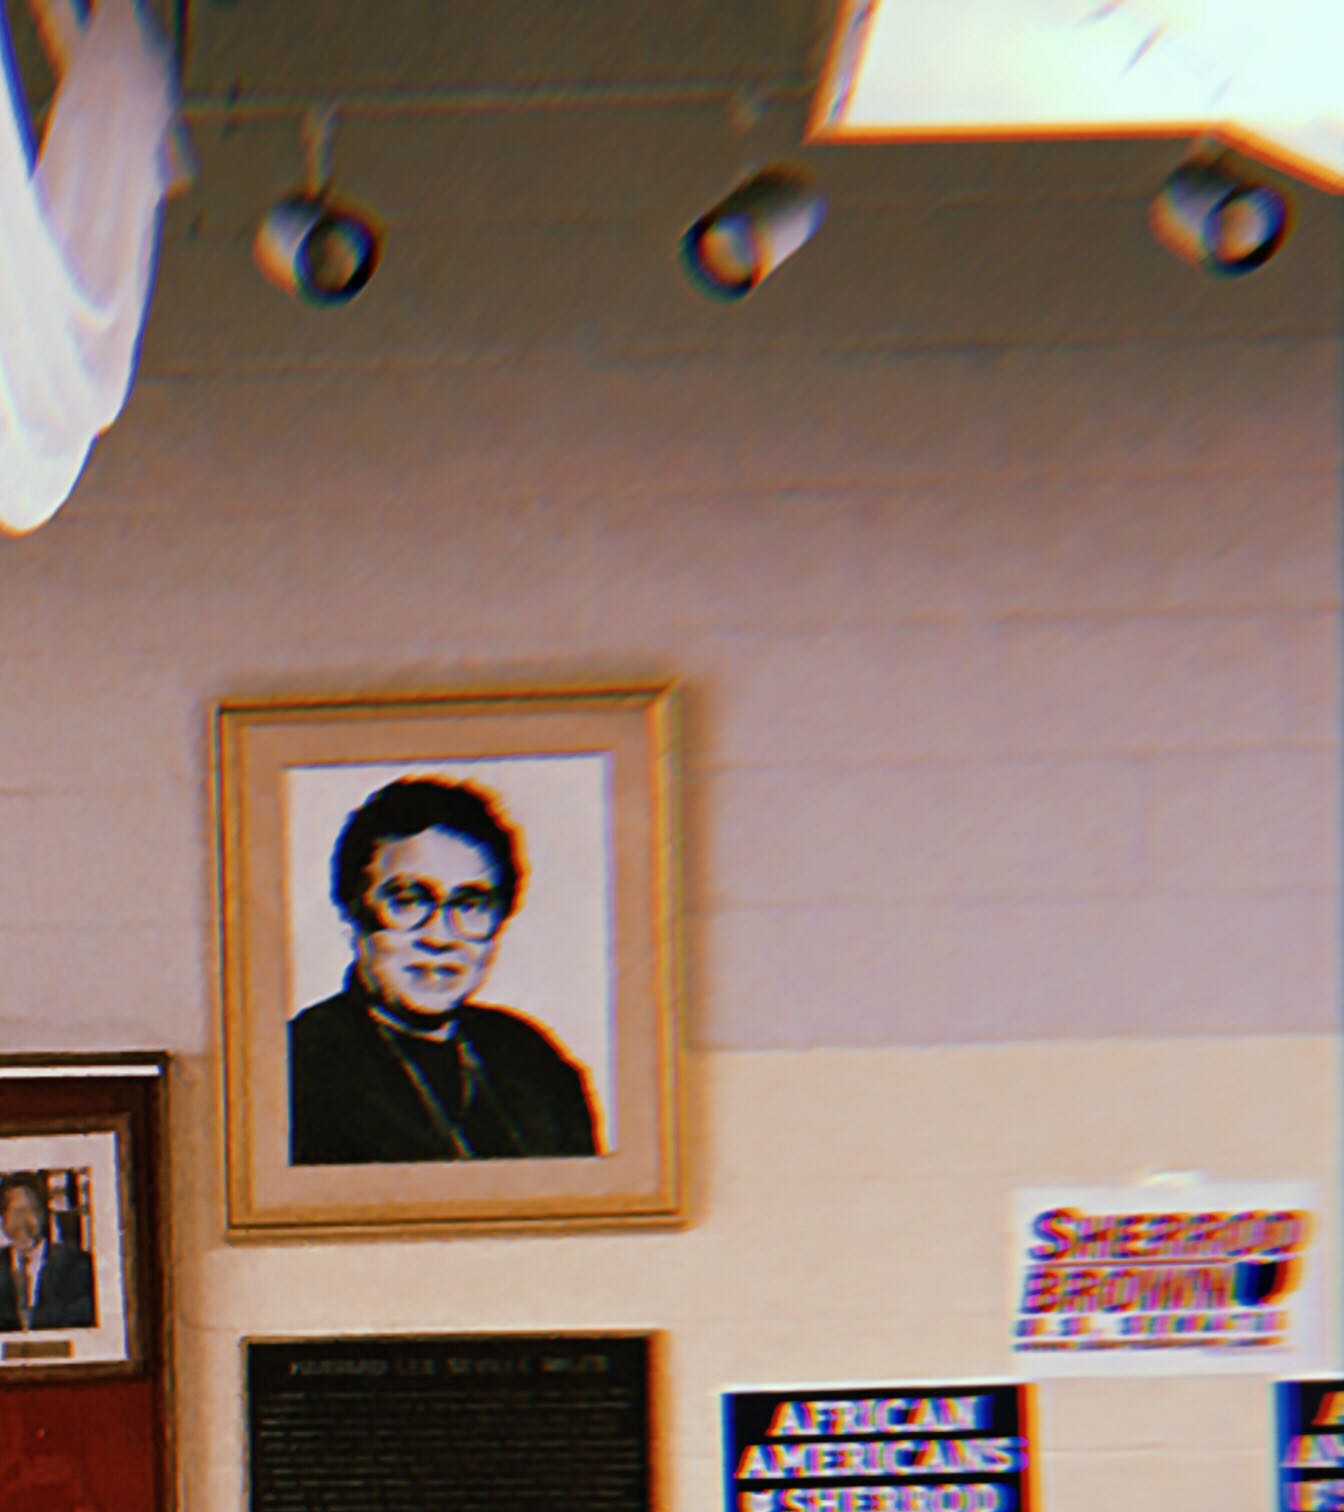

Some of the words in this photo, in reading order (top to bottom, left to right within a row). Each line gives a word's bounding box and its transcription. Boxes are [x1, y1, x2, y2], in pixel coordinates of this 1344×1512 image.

[1026, 1207, 1315, 1261] SHERROD
[1019, 1267, 1233, 1314] BROWN
[766, 1396, 990, 1437] AFRICAN
[735, 1437, 1027, 1479] AMERICANS
